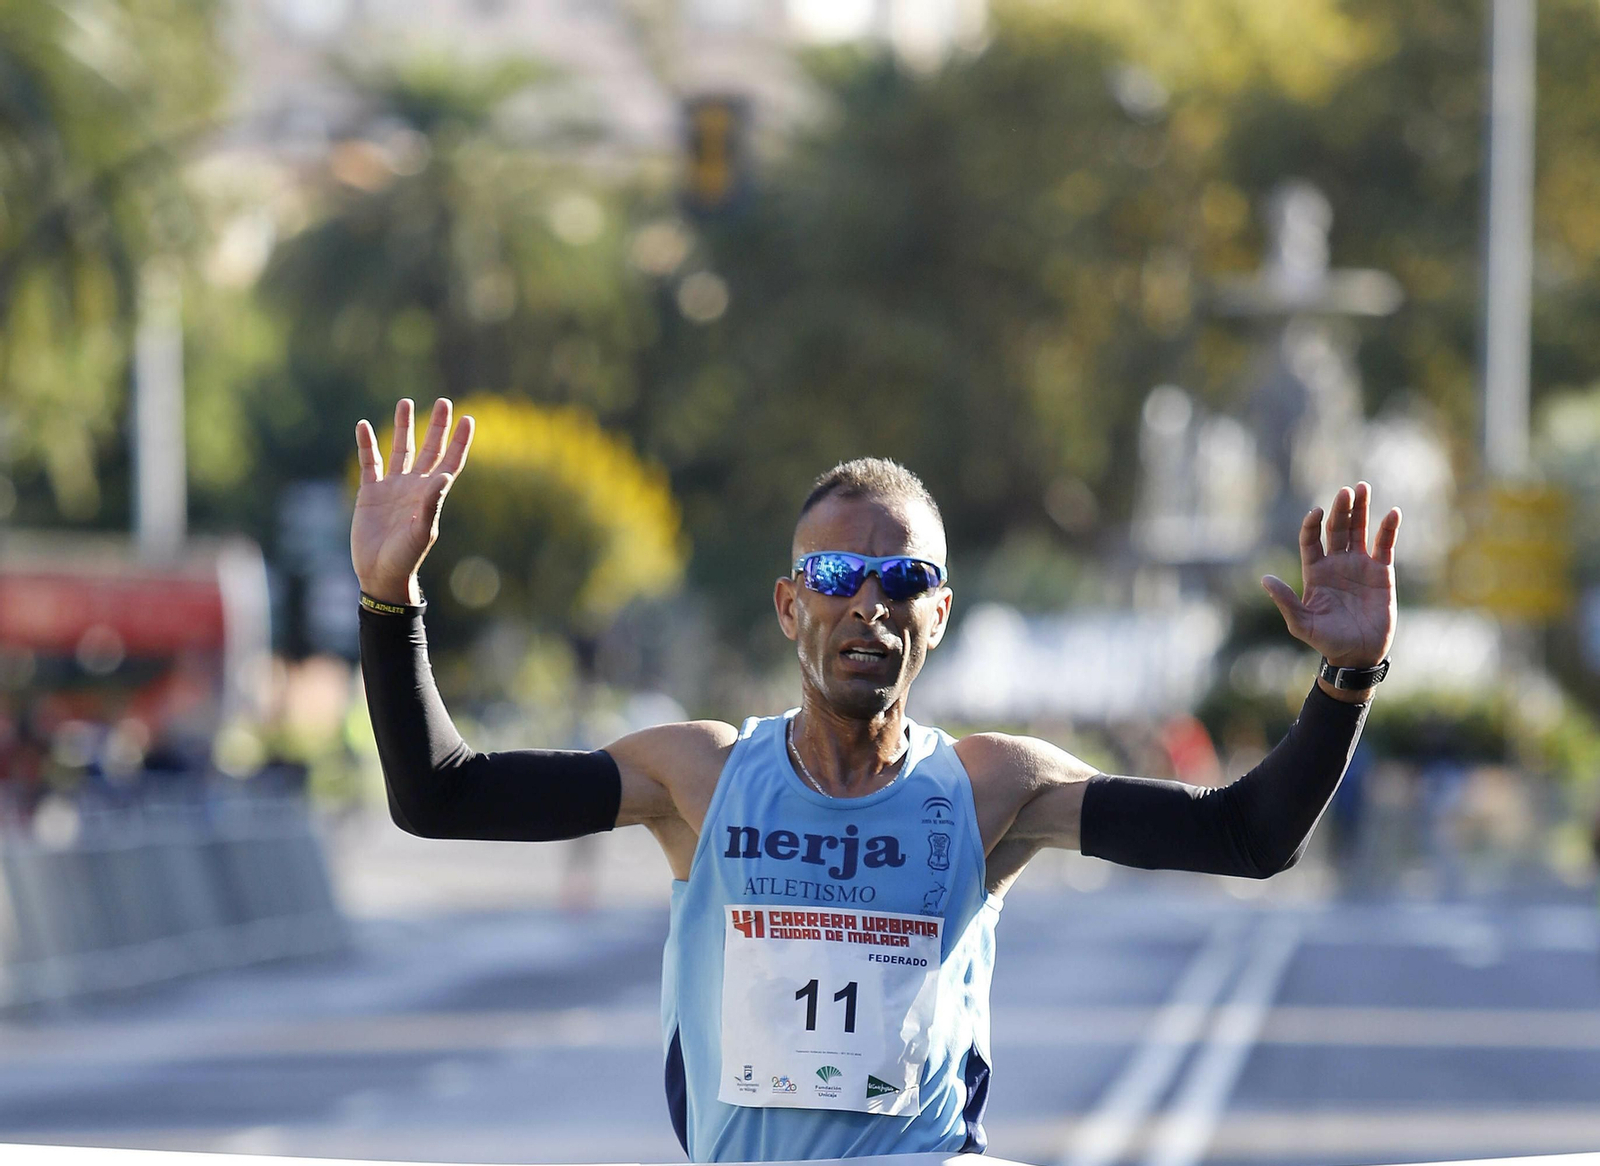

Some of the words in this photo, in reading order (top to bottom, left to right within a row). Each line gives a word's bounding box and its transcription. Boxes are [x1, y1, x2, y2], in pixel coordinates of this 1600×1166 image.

[724, 824, 906, 880] nerja
[743, 876, 877, 903] ATLETISMO
[731, 910, 765, 939] 41
[768, 911, 857, 930] CARRERA
[862, 915, 938, 938] URBANA
[770, 927, 821, 940] CIUDAD
[825, 929, 844, 942] DE
[868, 953, 928, 967] FEDERADO
[795, 979, 858, 1033] 11
